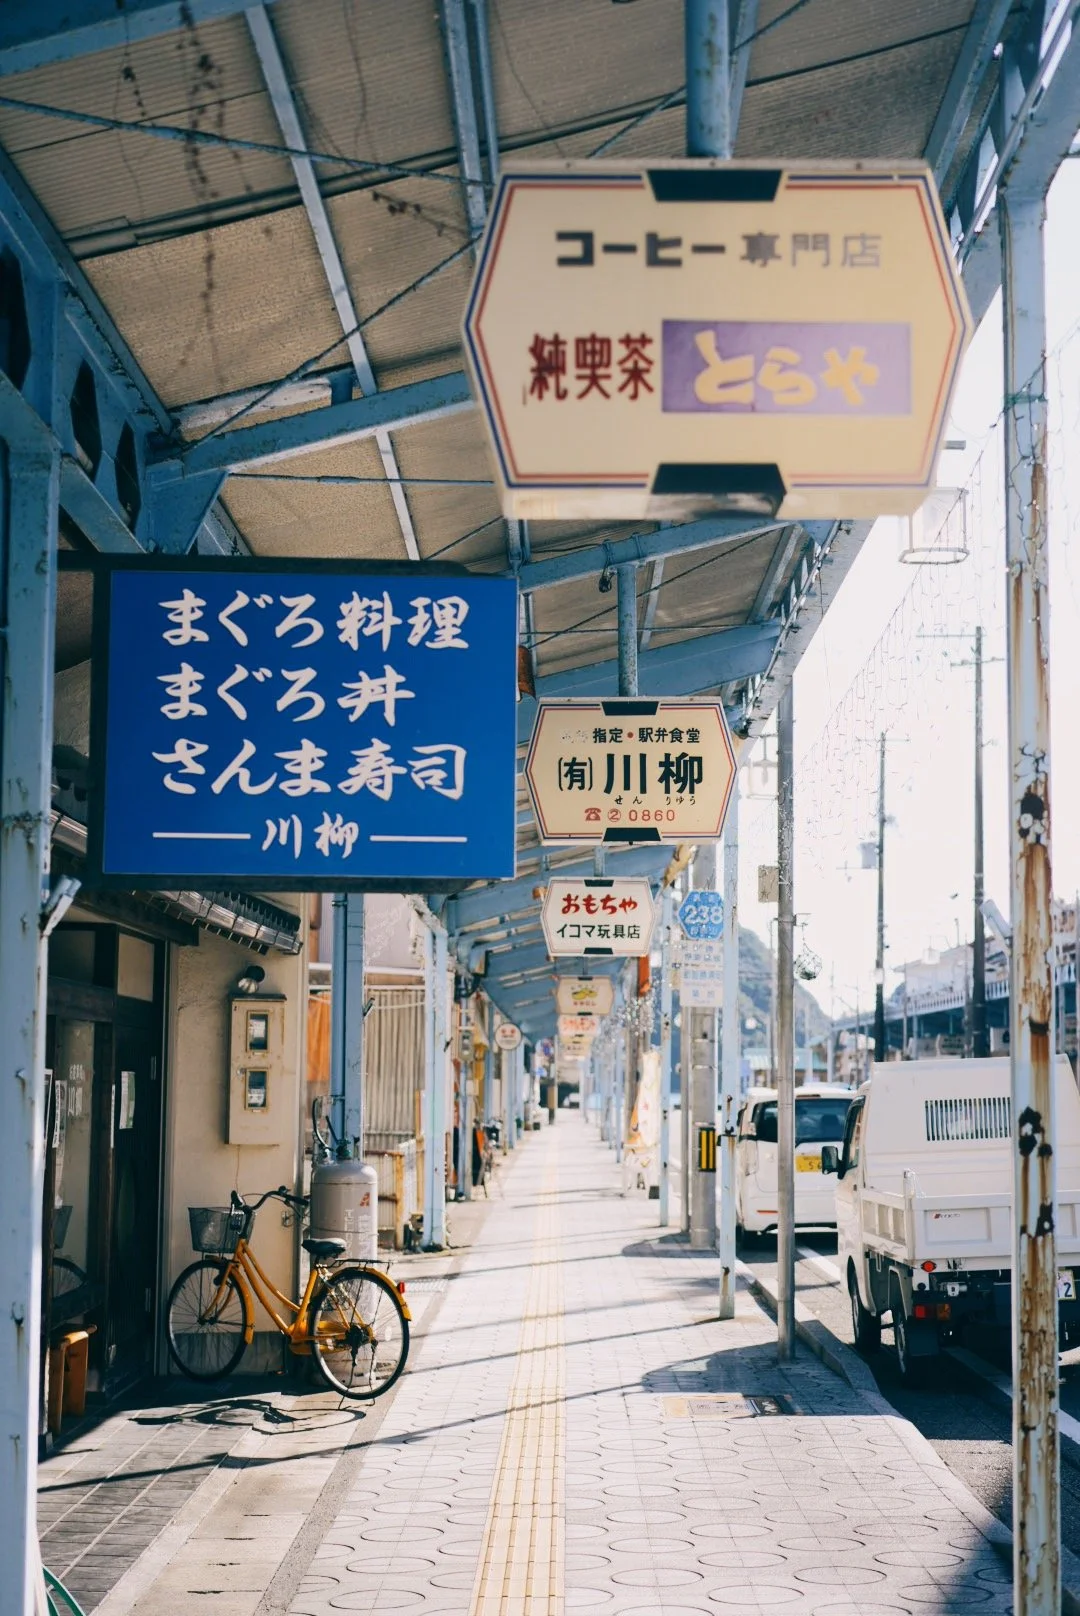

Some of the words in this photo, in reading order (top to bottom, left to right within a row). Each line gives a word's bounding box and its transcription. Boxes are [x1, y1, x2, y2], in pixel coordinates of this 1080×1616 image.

[556, 231, 882, 268] コーヒー専門店
[529, 332, 654, 401] 純喫茶
[695, 330, 879, 405] とらや
[158, 588, 470, 651] まぐろ料理
[157, 662, 415, 726] まぐろ丼
[152, 737, 467, 801] さんま寿司
[261, 810, 359, 859] 川柳
[561, 893, 638, 915] おもちゃ
[684, 904, 723, 924] 238
[556, 924, 641, 939] イコマ玩具店
